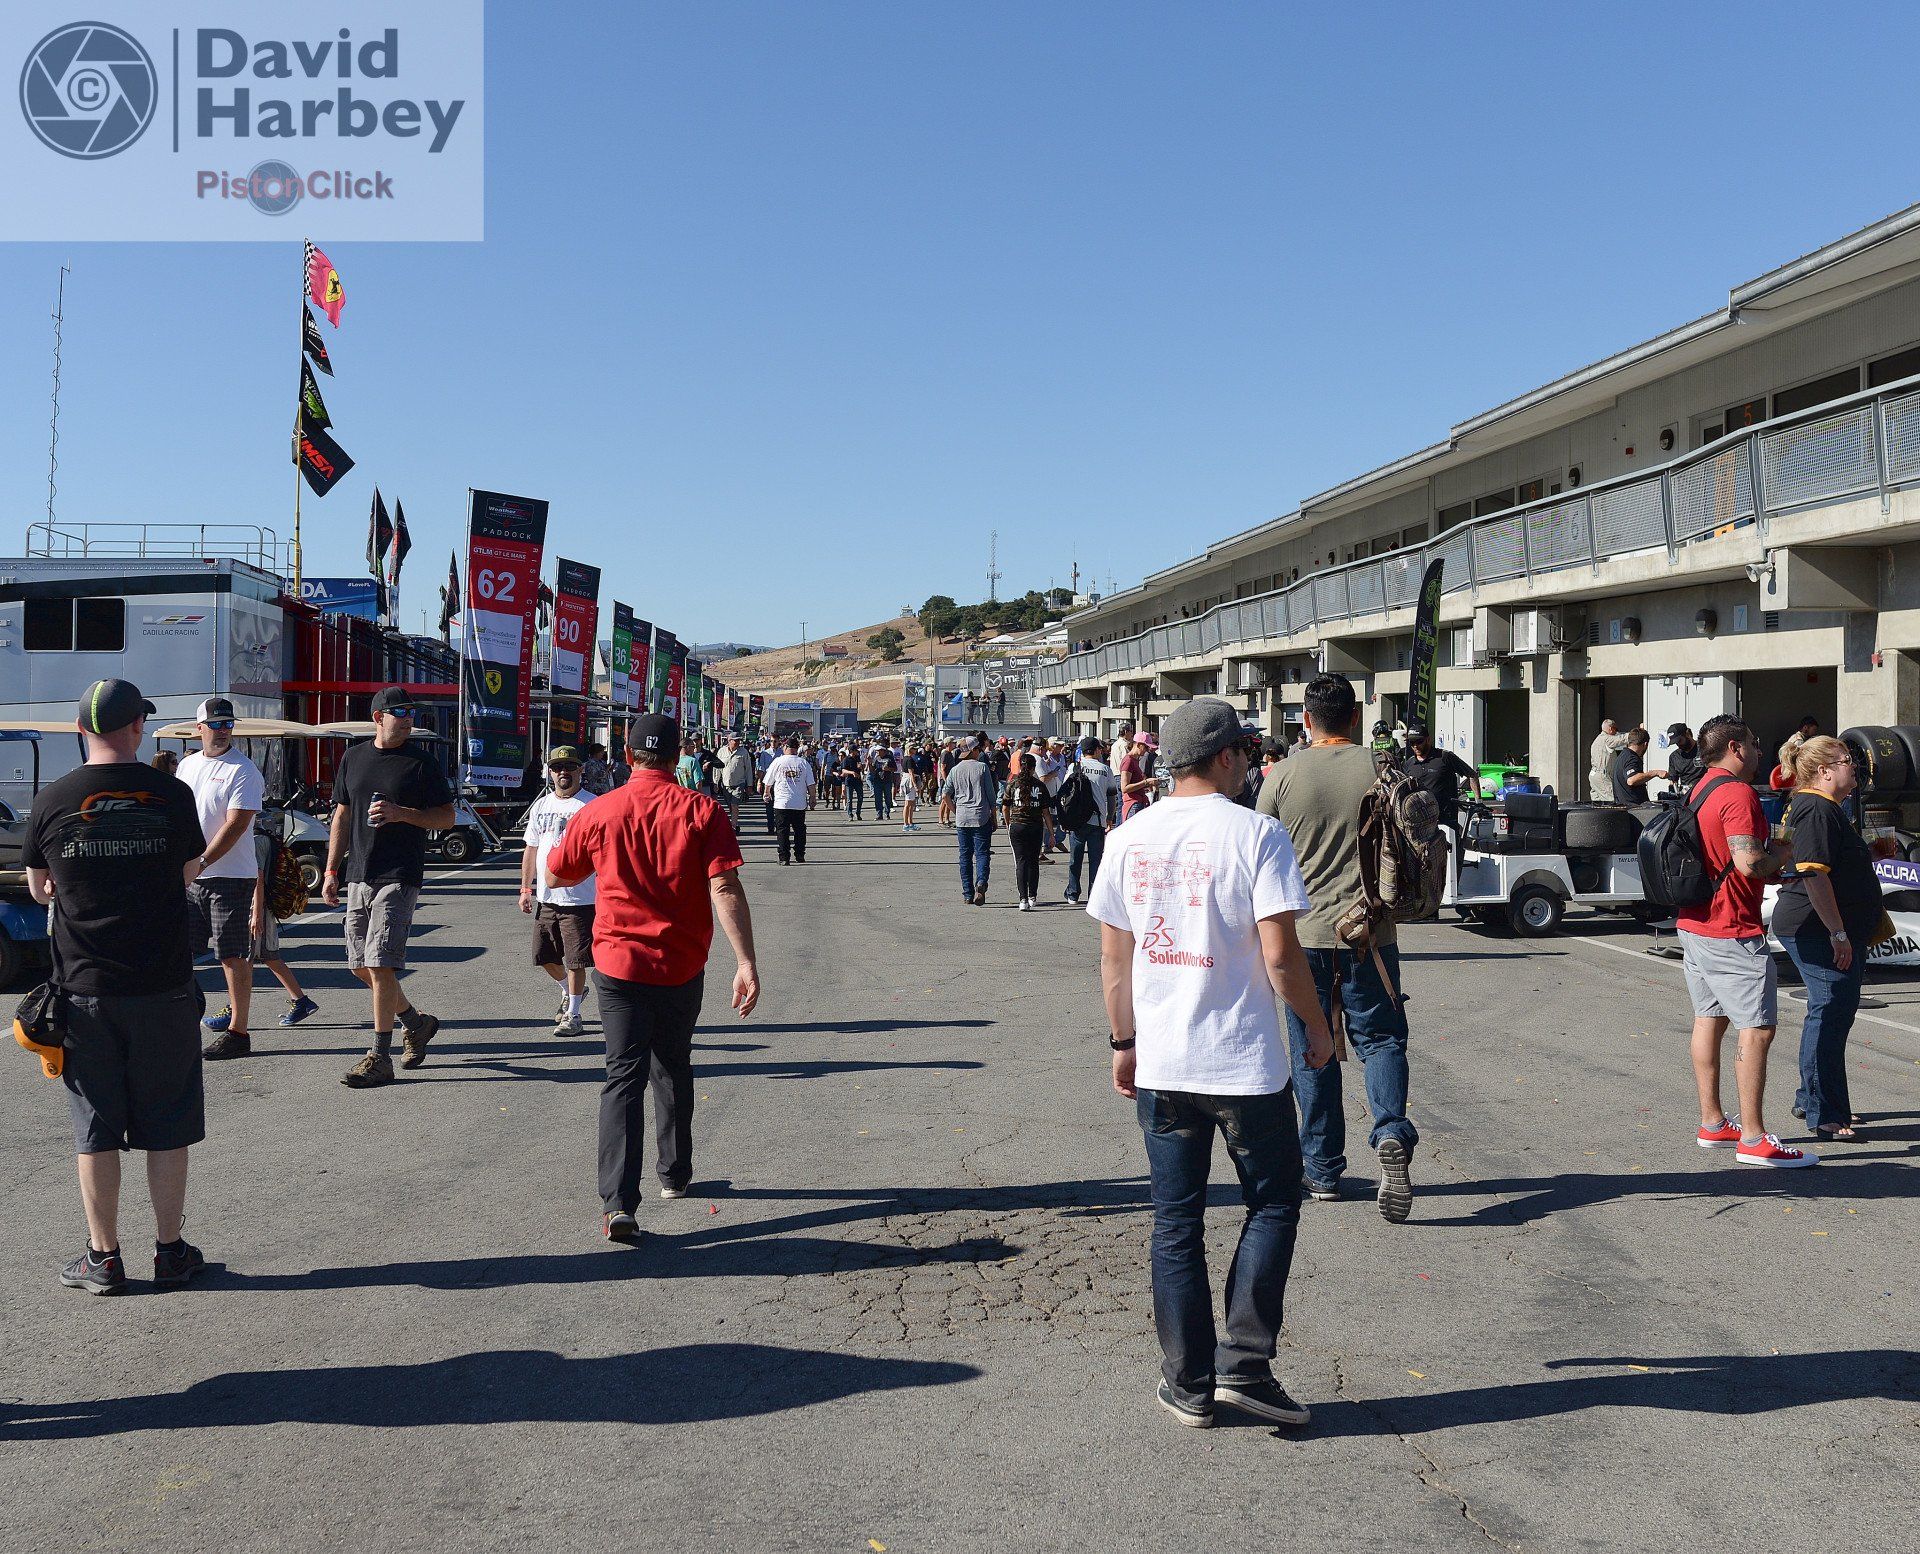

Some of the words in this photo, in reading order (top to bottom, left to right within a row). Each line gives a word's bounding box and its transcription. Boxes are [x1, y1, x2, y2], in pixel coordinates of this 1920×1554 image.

[483, 527, 532, 540] PADDOCK
[473, 546, 493, 555] GTLM
[477, 568, 516, 602] 62
[563, 587, 592, 598] PADDOCK
[559, 617, 580, 643] 90
[645, 735, 659, 748] 62
[79, 837, 167, 858] MOTORSPORTS
[1875, 862, 1919, 883] ACURA
[1148, 949, 1214, 968] SolidWorks
